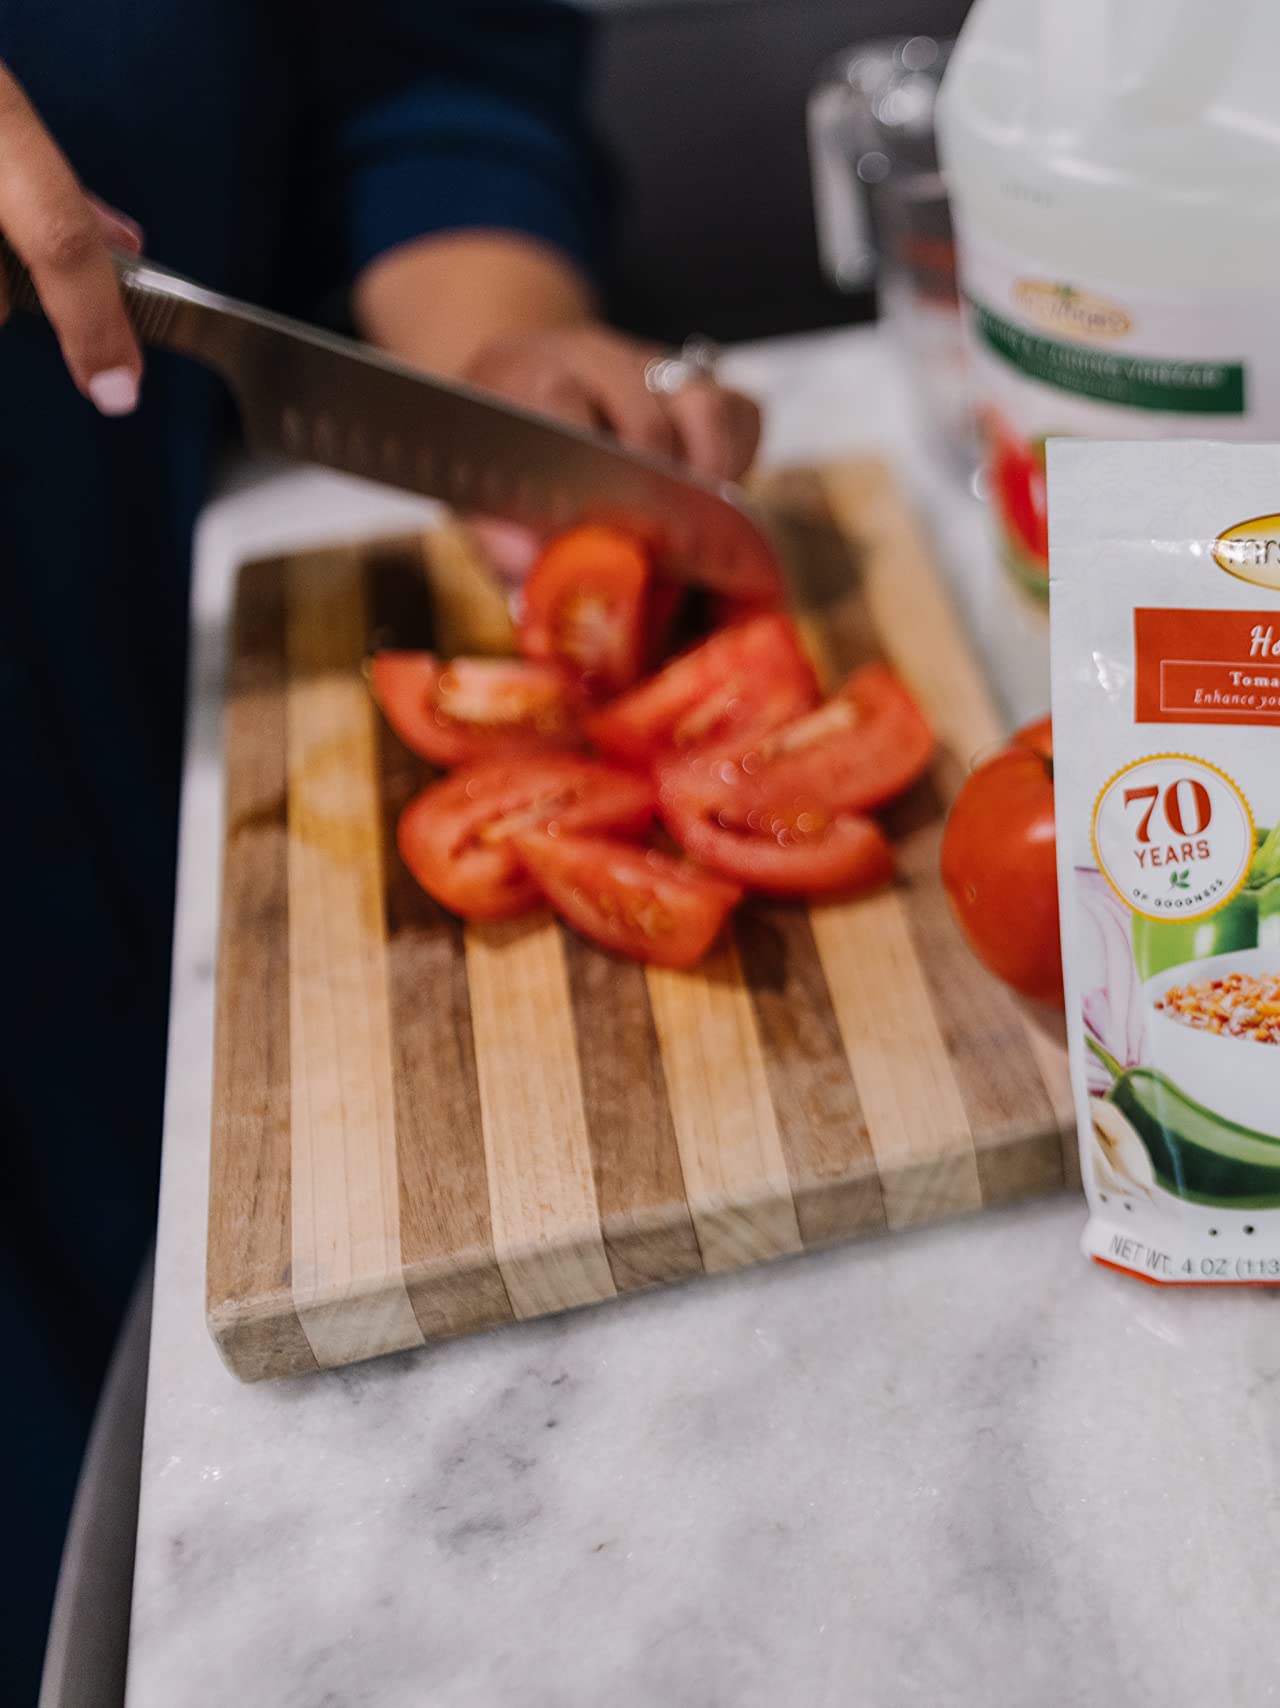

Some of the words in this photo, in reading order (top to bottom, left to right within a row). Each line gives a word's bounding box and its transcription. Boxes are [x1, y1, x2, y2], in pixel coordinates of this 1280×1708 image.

[1194, 689, 1254, 705] Enhance
[1123, 778, 1212, 843] 70
[1134, 840, 1210, 869] YEARS
[1154, 879, 1223, 908] GOODNESS
[1109, 1234, 1144, 1261] NET
[1181, 1260, 1192, 1275] 4
[1201, 1259, 1228, 1275] OZ
